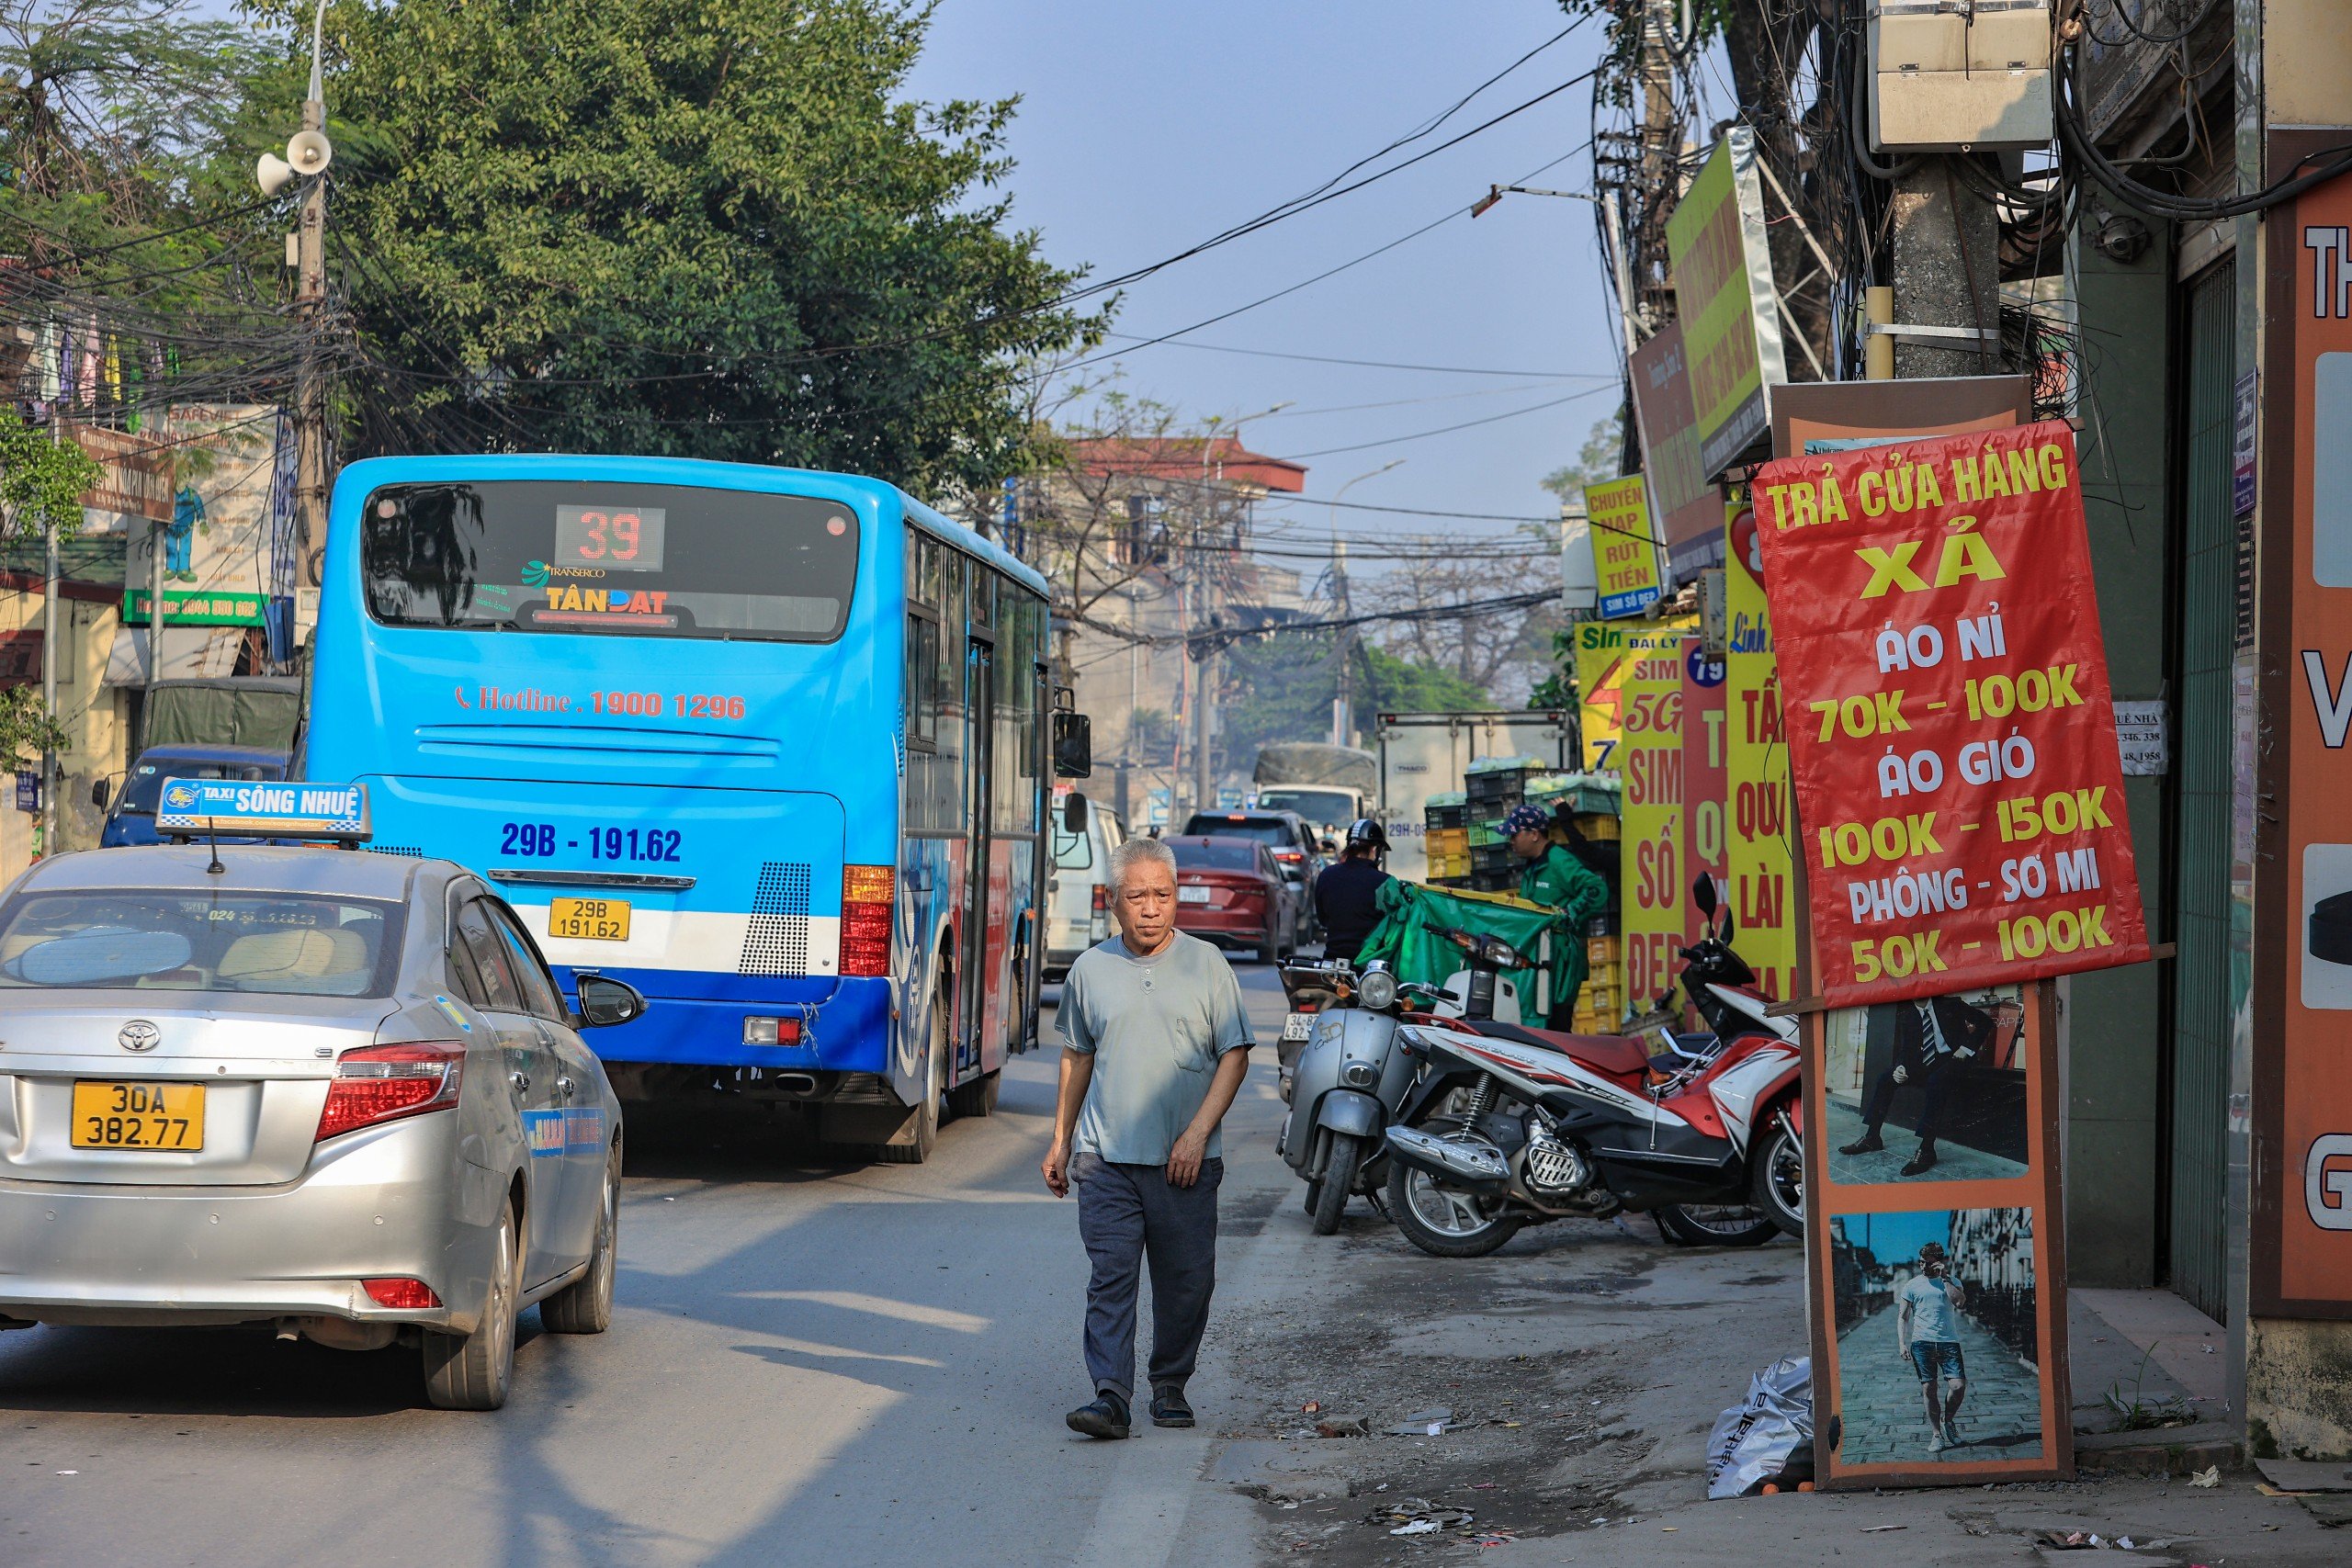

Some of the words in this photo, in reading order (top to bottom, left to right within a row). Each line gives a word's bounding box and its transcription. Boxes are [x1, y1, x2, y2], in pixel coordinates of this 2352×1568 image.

[1767, 461, 1849, 530] TRẢ
[1858, 451, 1942, 515] CỬA
[1951, 443, 2068, 504] HÀNG
[580, 510, 642, 562] 39
[1606, 540, 1640, 565] RÚT
[550, 567, 605, 579] TRANSERCO
[1854, 515, 2007, 600] XẢ
[1607, 564, 1649, 591] TIỀN
[1629, 639, 1658, 652] ĐẠI
[1661, 637, 1678, 649] LÝ
[1876, 620, 1944, 674] ÁO
[1957, 601, 2007, 661] NỈ
[1634, 660, 1678, 681] SIM
[479, 686, 571, 713] Hotline
[589, 692, 662, 716] 1900
[674, 694, 746, 720] 1296
[1625, 691, 1683, 735] 5G
[1810, 687, 1912, 743] 70K
[1964, 662, 2085, 722] 100K
[2134, 712, 2158, 724] NHÀ
[2143, 732, 2161, 742] 338
[1877, 746, 1944, 798] ÁO
[1959, 727, 2035, 787] GIÓ
[2139, 751, 2161, 761] 1958
[1629, 749, 1682, 806] SIM
[205, 786, 235, 799] TAXI
[235, 784, 294, 814] SÔNG
[300, 787, 358, 820] NHUỆ
[501, 823, 556, 857] 29B
[589, 827, 681, 863] 191.62
[1818, 812, 1944, 868] 100K
[1996, 785, 2114, 843] 150K
[1636, 815, 1676, 910] SỐ
[1849, 862, 1968, 925] PHÔNG
[2003, 853, 2050, 903] SƠ
[2056, 847, 2101, 895] MI
[209, 909, 235, 921] 024
[572, 900, 607, 919] 29B
[560, 919, 622, 939] 191.62
[1851, 929, 1949, 984] 50K
[1996, 905, 2114, 964] 100K
[111, 1087, 166, 1114] 30A
[86, 1117, 189, 1146] 382.77
